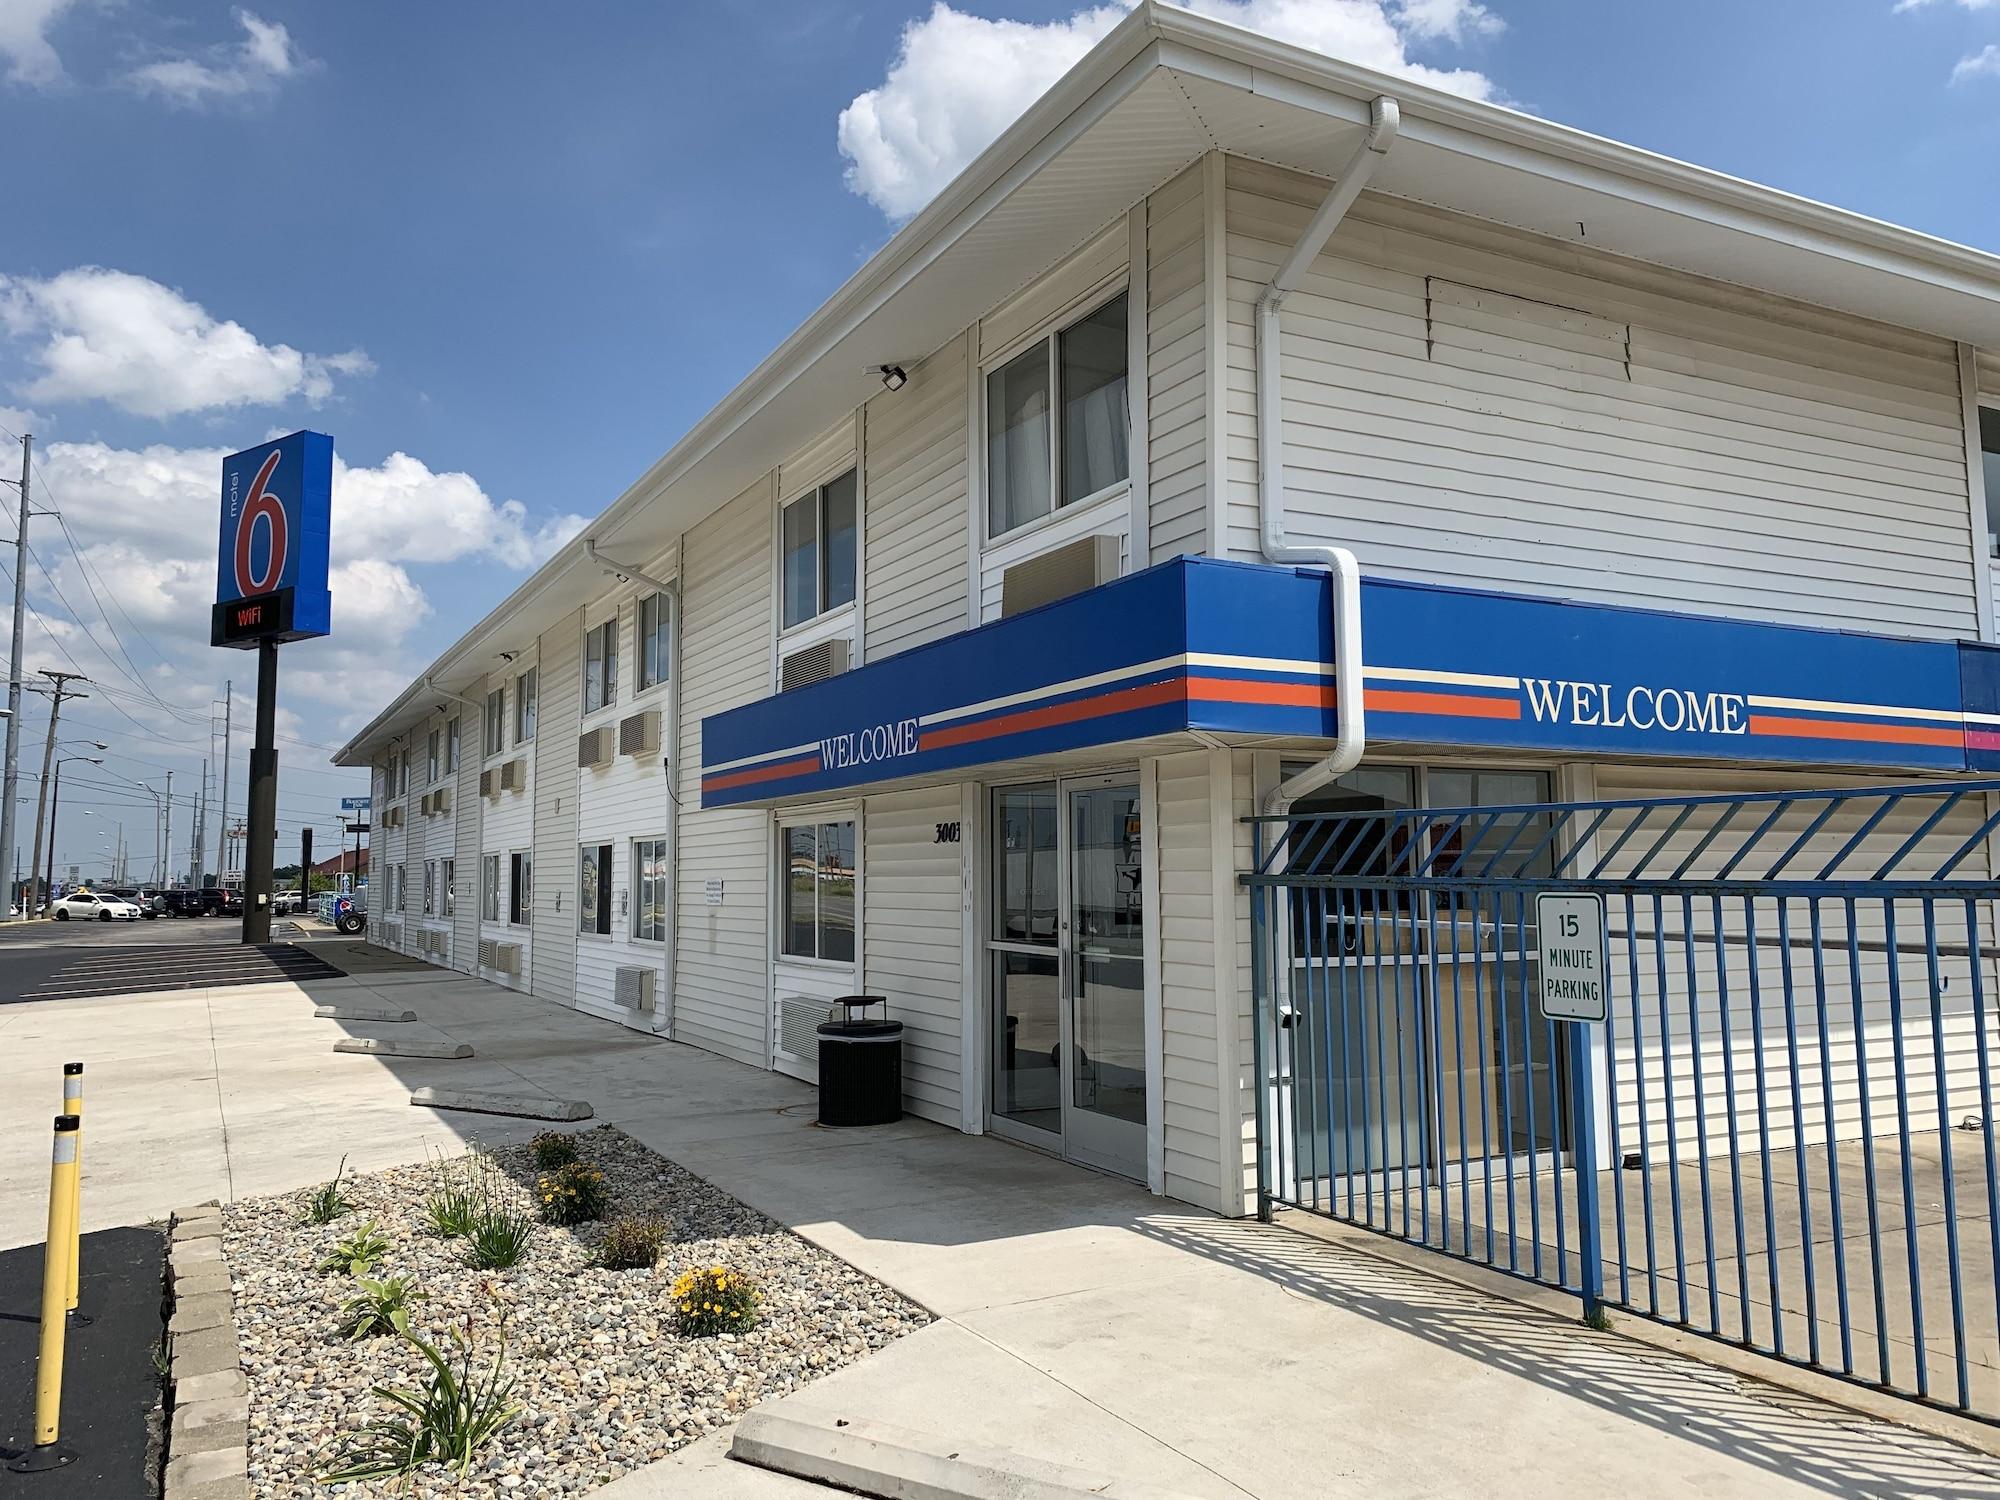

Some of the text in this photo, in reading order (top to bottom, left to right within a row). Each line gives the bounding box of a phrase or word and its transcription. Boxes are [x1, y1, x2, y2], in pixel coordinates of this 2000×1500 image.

[230, 471, 239, 518] motel
[235, 449, 288, 598] 6
[237, 606, 262, 627] WiFi
[1522, 677, 1748, 735] WELCOME
[820, 717, 919, 771] WELCOME
[933, 821, 961, 844] 3003
[1559, 914, 1579, 938] 15
[1549, 948, 1594, 969] MINUTE
[1547, 978, 1599, 1001] PARKING
